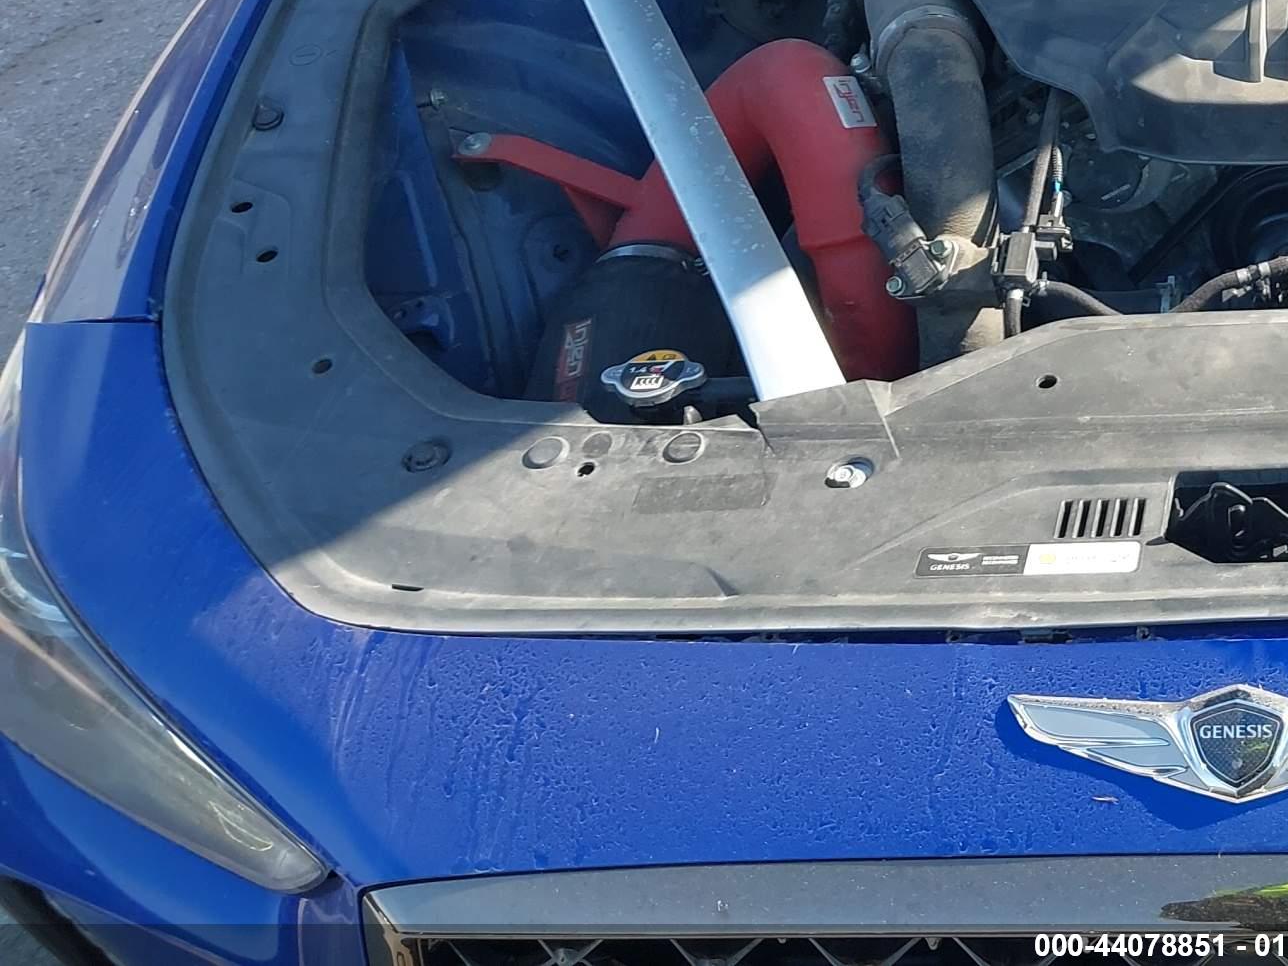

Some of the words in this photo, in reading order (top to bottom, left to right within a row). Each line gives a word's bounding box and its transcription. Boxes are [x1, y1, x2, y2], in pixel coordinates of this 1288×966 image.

[833, 78, 866, 123] injen
[929, 562, 971, 572] GENESIS
[1199, 723, 1274, 740] GENESIS
